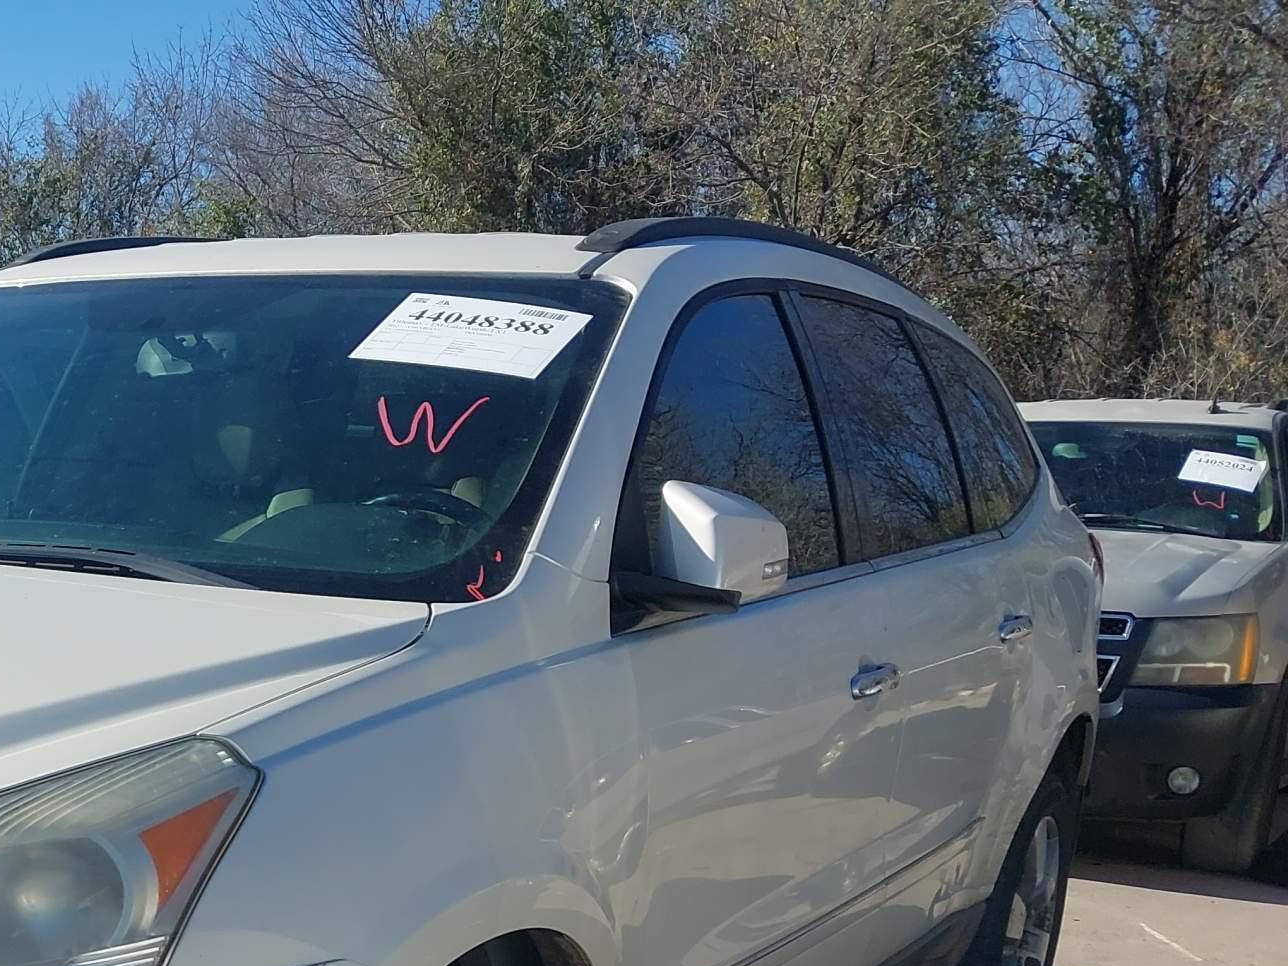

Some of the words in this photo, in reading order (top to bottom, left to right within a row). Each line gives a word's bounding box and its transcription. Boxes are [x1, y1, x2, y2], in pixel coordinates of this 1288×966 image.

[408, 308, 555, 336] 44048388
[377, 396, 490, 454] W
[1196, 457, 1254, 472] 44052024
